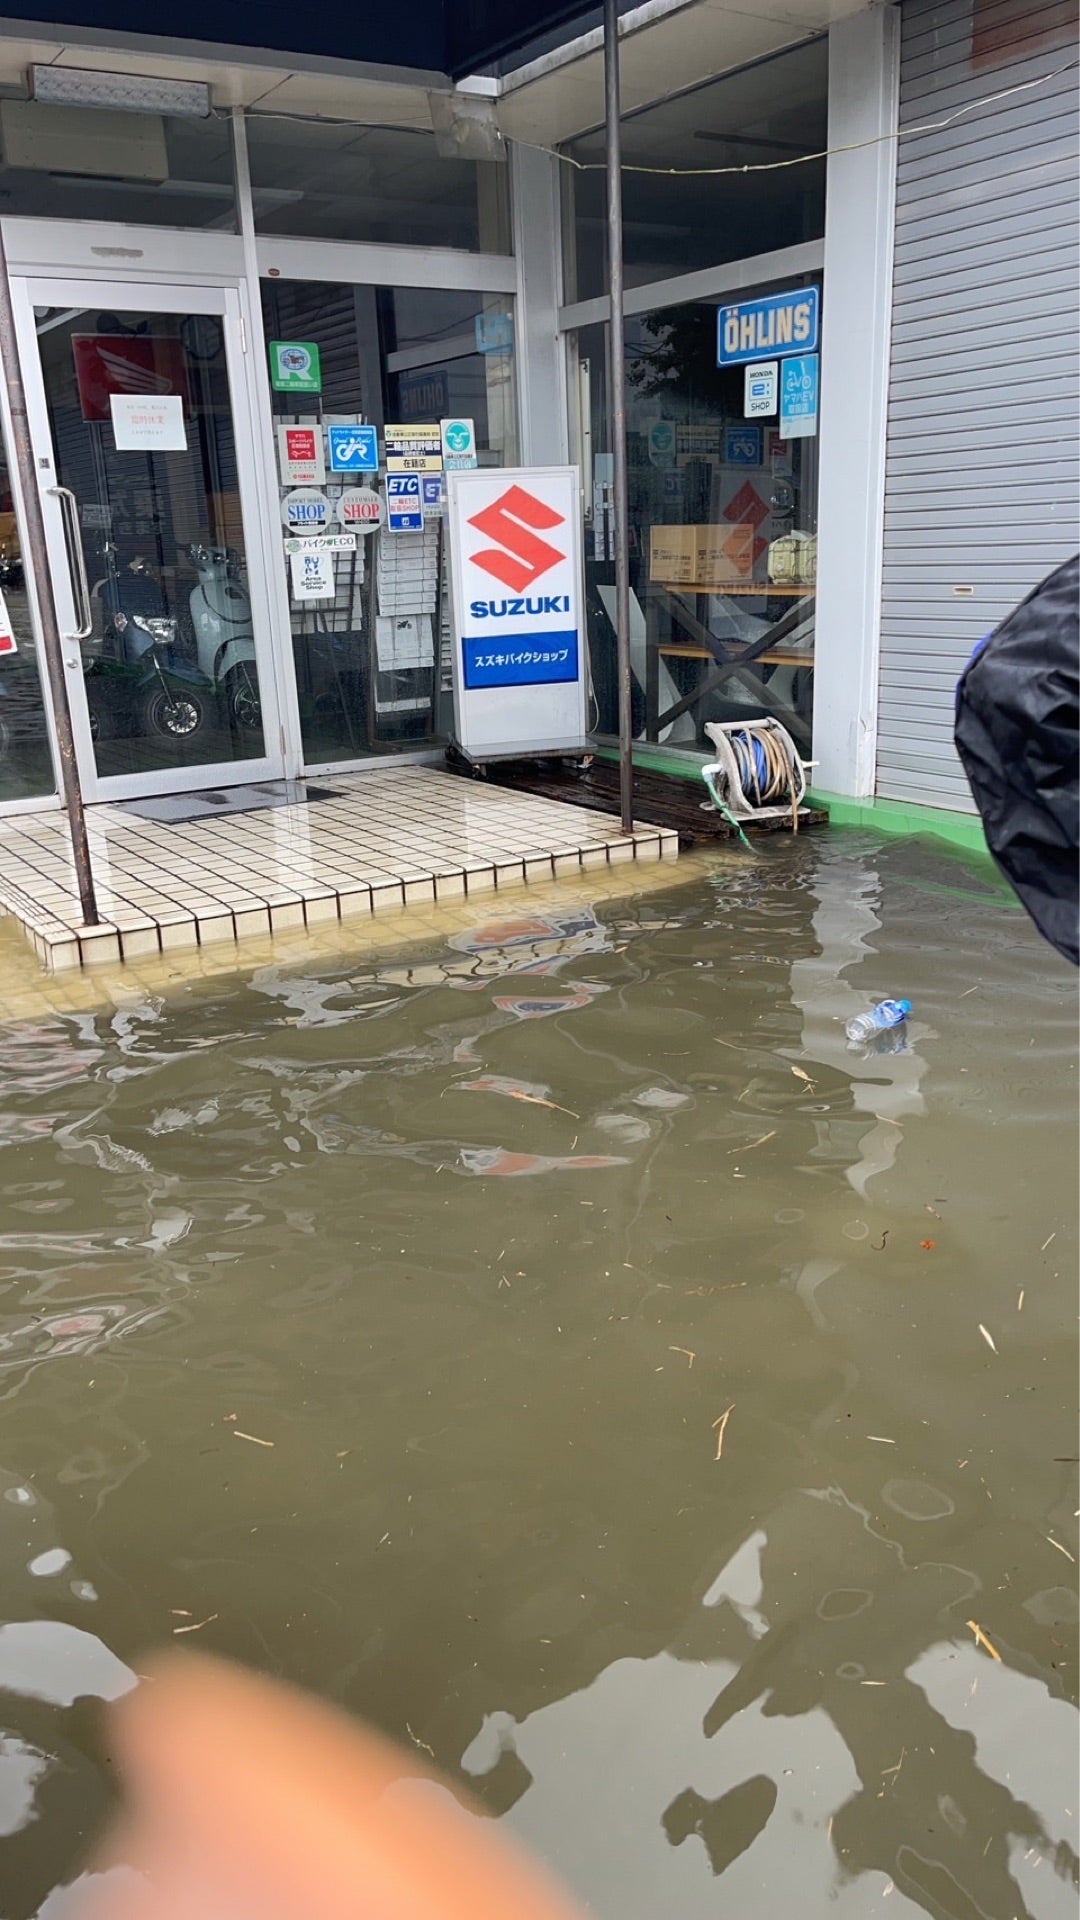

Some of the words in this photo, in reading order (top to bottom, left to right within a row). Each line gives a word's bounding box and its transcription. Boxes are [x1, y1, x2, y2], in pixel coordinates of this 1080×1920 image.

[724, 303, 810, 353] ÖHLINS
[750, 370, 773, 378] HONDA
[751, 401, 770, 411] SHOP
[403, 459, 426, 468] 在籍店
[388, 478, 418, 493] ETC
[288, 505, 325, 519] SHOP
[344, 504, 379, 518] SHOP
[334, 537, 354, 546] ECO
[470, 596, 569, 618] SUZUKI
[475, 649, 569, 668] スズキバイクショップ
